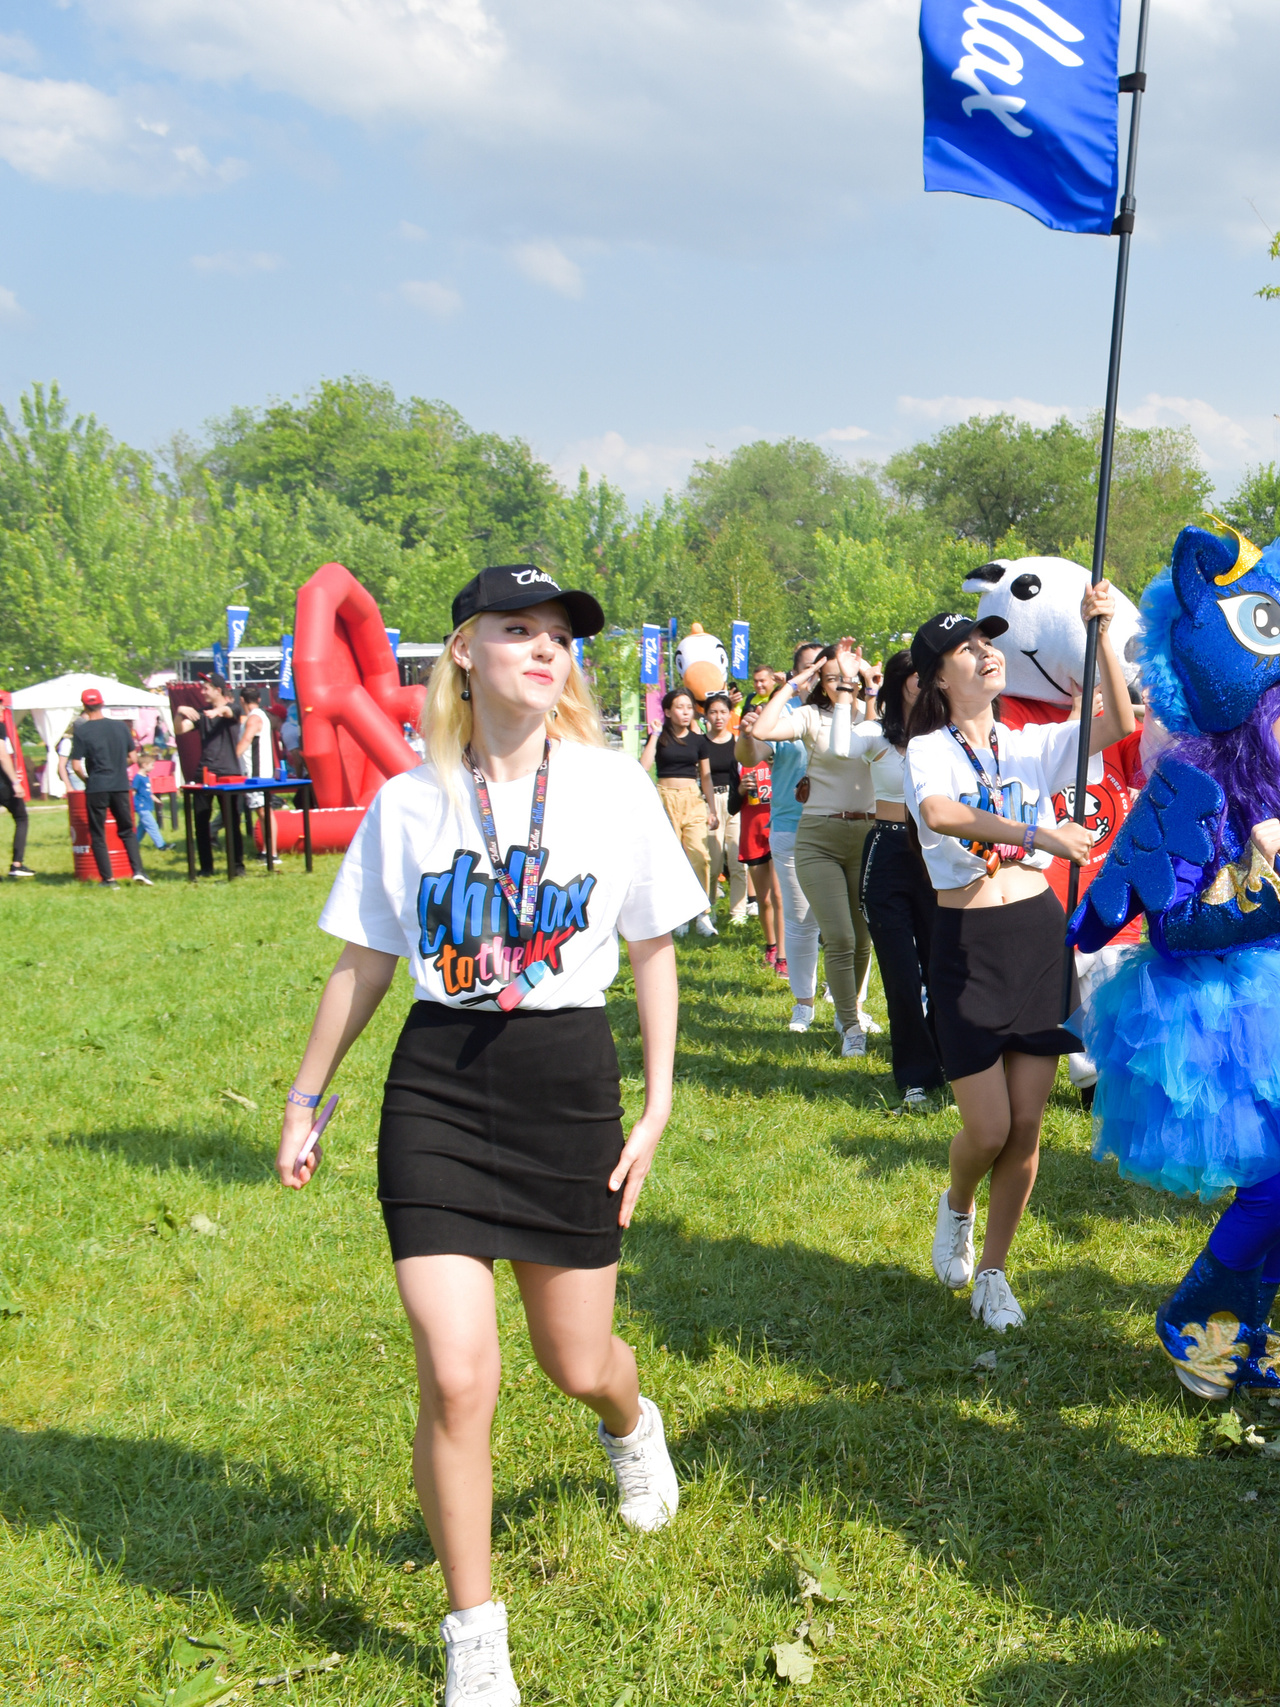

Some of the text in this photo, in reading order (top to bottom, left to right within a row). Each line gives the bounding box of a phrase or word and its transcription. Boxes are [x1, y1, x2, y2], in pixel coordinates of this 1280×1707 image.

[1106, 773, 1122, 792] FREE
[436, 944, 475, 994] to
[474, 936, 525, 981] the
